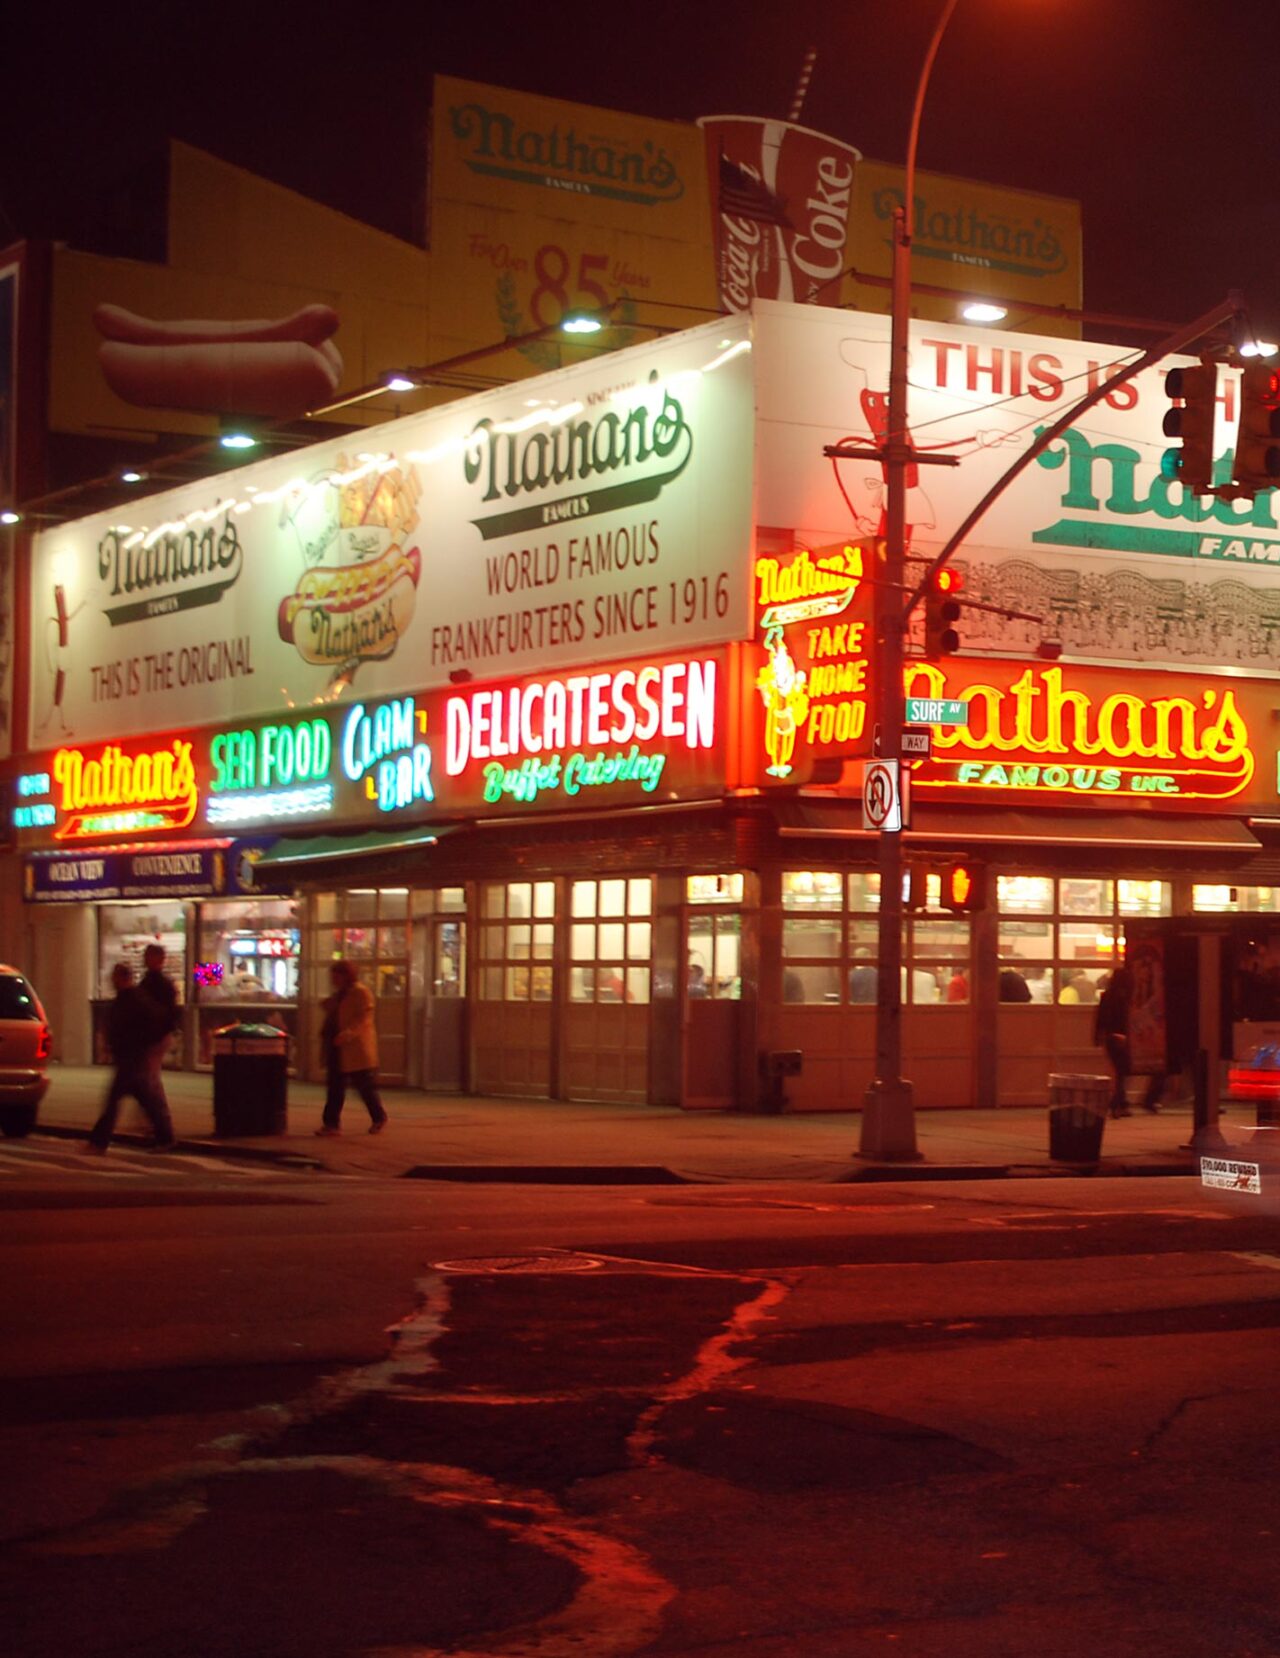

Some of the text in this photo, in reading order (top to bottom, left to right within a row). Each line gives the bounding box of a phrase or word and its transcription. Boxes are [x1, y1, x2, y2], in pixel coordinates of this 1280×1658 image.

[450, 102, 685, 190] Nathan's
[792, 157, 852, 279] Coke
[530, 244, 610, 330] 85
[922, 339, 1064, 402] THIS
[1086, 360, 1139, 411] IS
[542, 497, 590, 523] FAMOUS
[486, 520, 660, 596] WORLD FAMOUS
[430, 599, 586, 666] FRANKFURTERS
[593, 586, 658, 640] SINCE
[669, 572, 729, 625] 1916
[807, 622, 865, 659] TAKE
[90, 635, 254, 702] THIS IS THE ORIGINAL
[808, 660, 868, 698] HOME
[343, 698, 416, 781] CLAM
[445, 660, 716, 776] DELICATESSEN
[807, 700, 866, 744] FOOD
[906, 737, 925, 749] WAY
[911, 702, 961, 721] SURF AV
[54, 740, 196, 811] Nathan's
[209, 719, 331, 792] SEA FOOD
[378, 744, 435, 812] BAR
[482, 744, 666, 803] Buffet Catering
[957, 762, 1122, 792] FAMOUS
